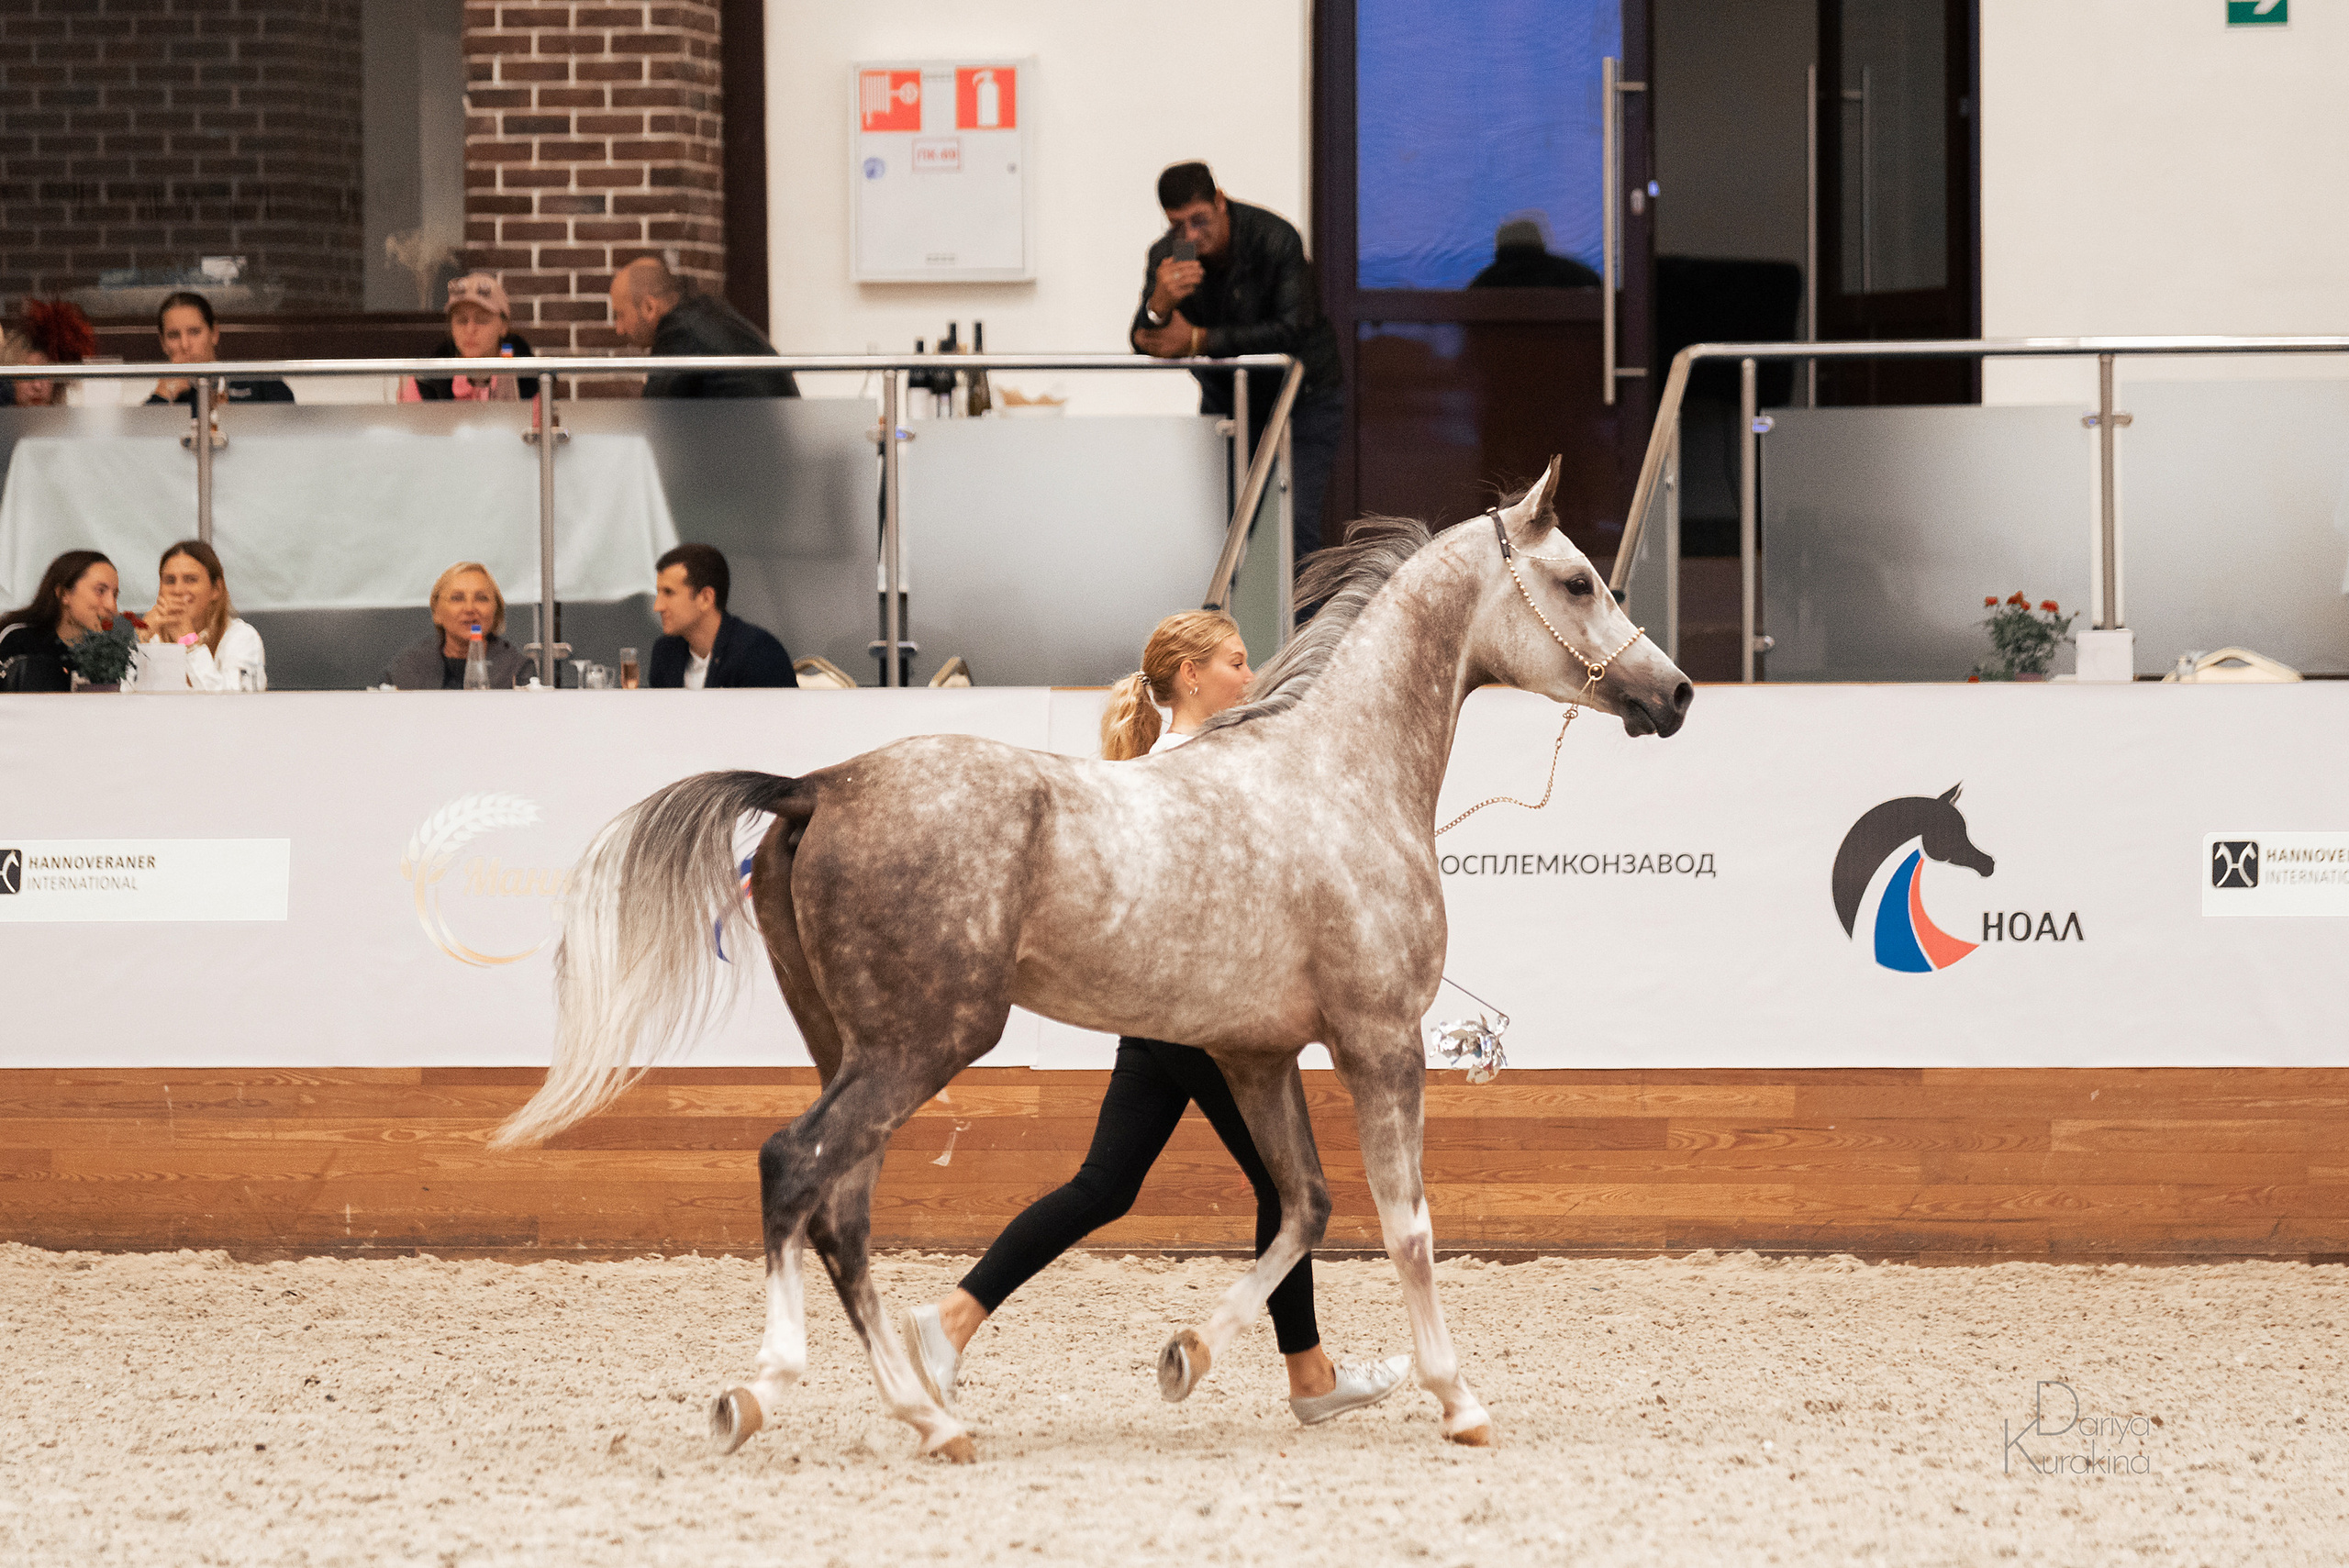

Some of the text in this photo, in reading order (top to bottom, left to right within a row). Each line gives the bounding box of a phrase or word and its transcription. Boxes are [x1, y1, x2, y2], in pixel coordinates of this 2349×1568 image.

[28, 855, 156, 870] HANNOVERANER
[2266, 848, 2349, 863] HANNOVE
[1441, 853, 1716, 878] ОСПЛЕМКОНЗАВОД
[27, 875, 138, 891] INTERNATIONAL
[1983, 912, 2084, 941] НОАЛ
